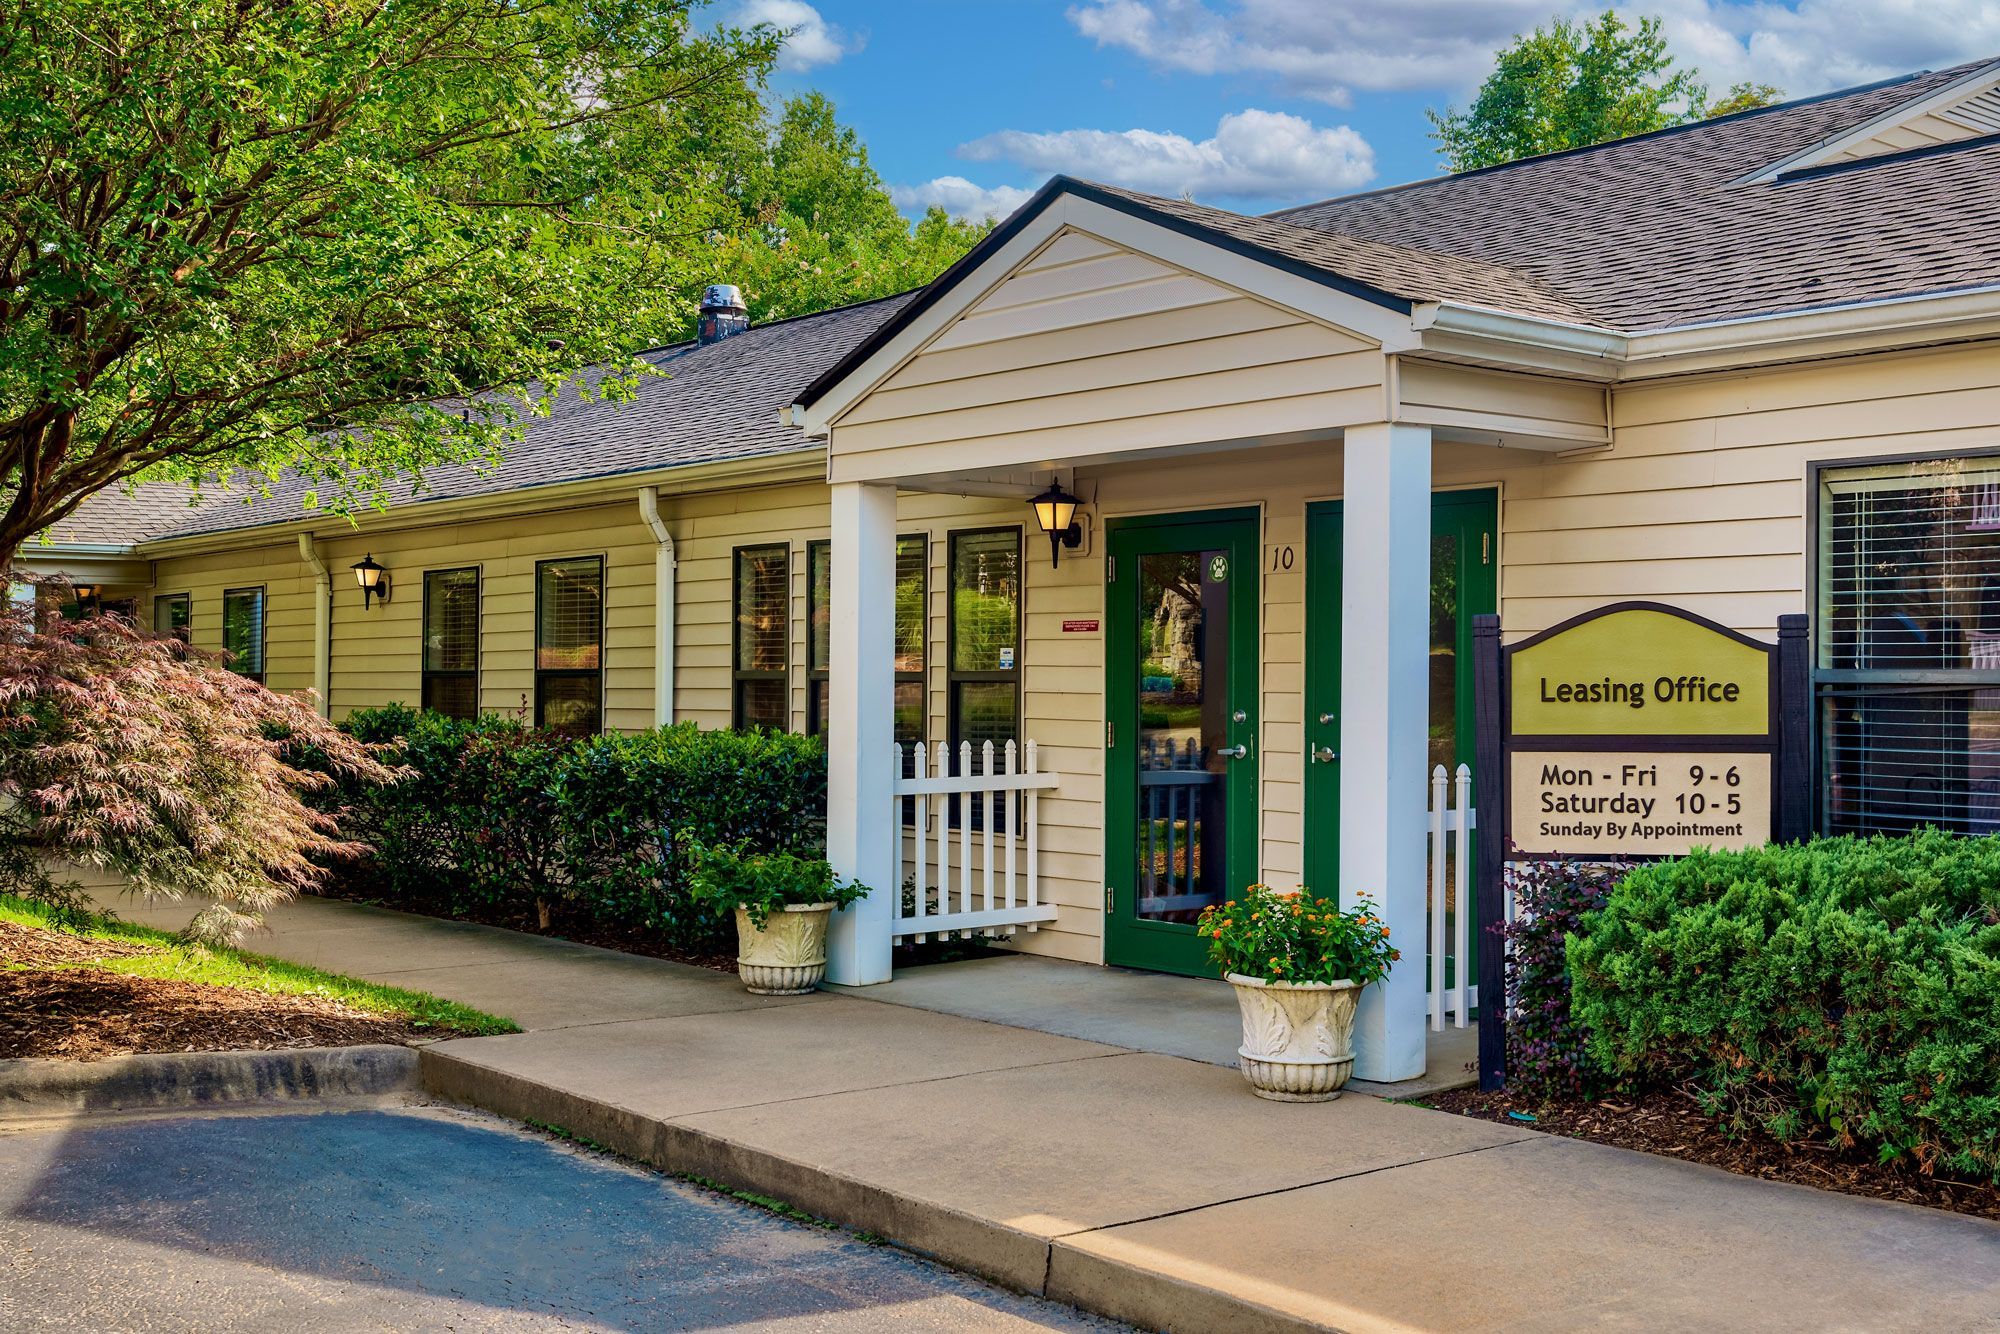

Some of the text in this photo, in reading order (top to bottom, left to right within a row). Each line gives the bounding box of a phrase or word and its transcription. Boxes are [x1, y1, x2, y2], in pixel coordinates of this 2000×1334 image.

[1273, 546, 1294, 571] 10
[1540, 676, 1740, 709] Leasing Office
[1540, 764, 1593, 787] Mon
[1622, 764, 1657, 787] Fri
[1541, 791, 1656, 819] Saturday
[1539, 821, 1743, 840] Sunday By Appointment
